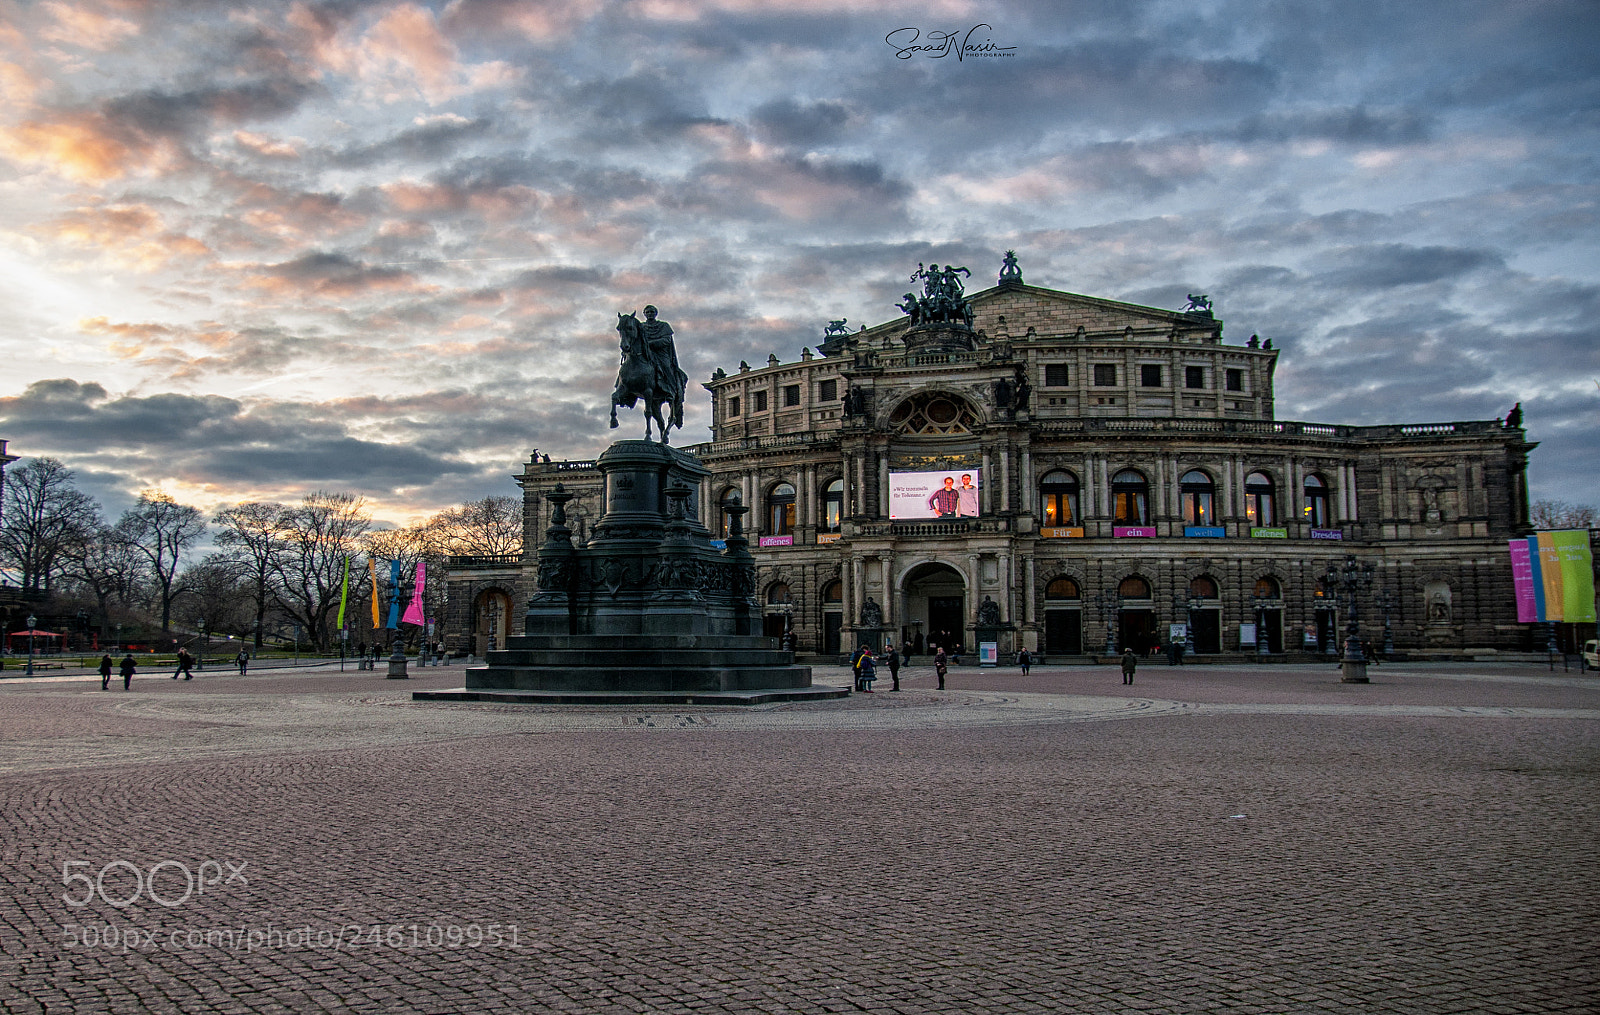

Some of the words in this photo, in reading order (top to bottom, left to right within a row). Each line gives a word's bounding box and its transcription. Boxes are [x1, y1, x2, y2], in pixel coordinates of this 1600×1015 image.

[1053, 529, 1072, 537] Für
[1127, 528, 1143, 537] ein
[1254, 530, 1284, 538] offenes
[1311, 530, 1342, 540] Dresden
[762, 537, 790, 546] offenes
